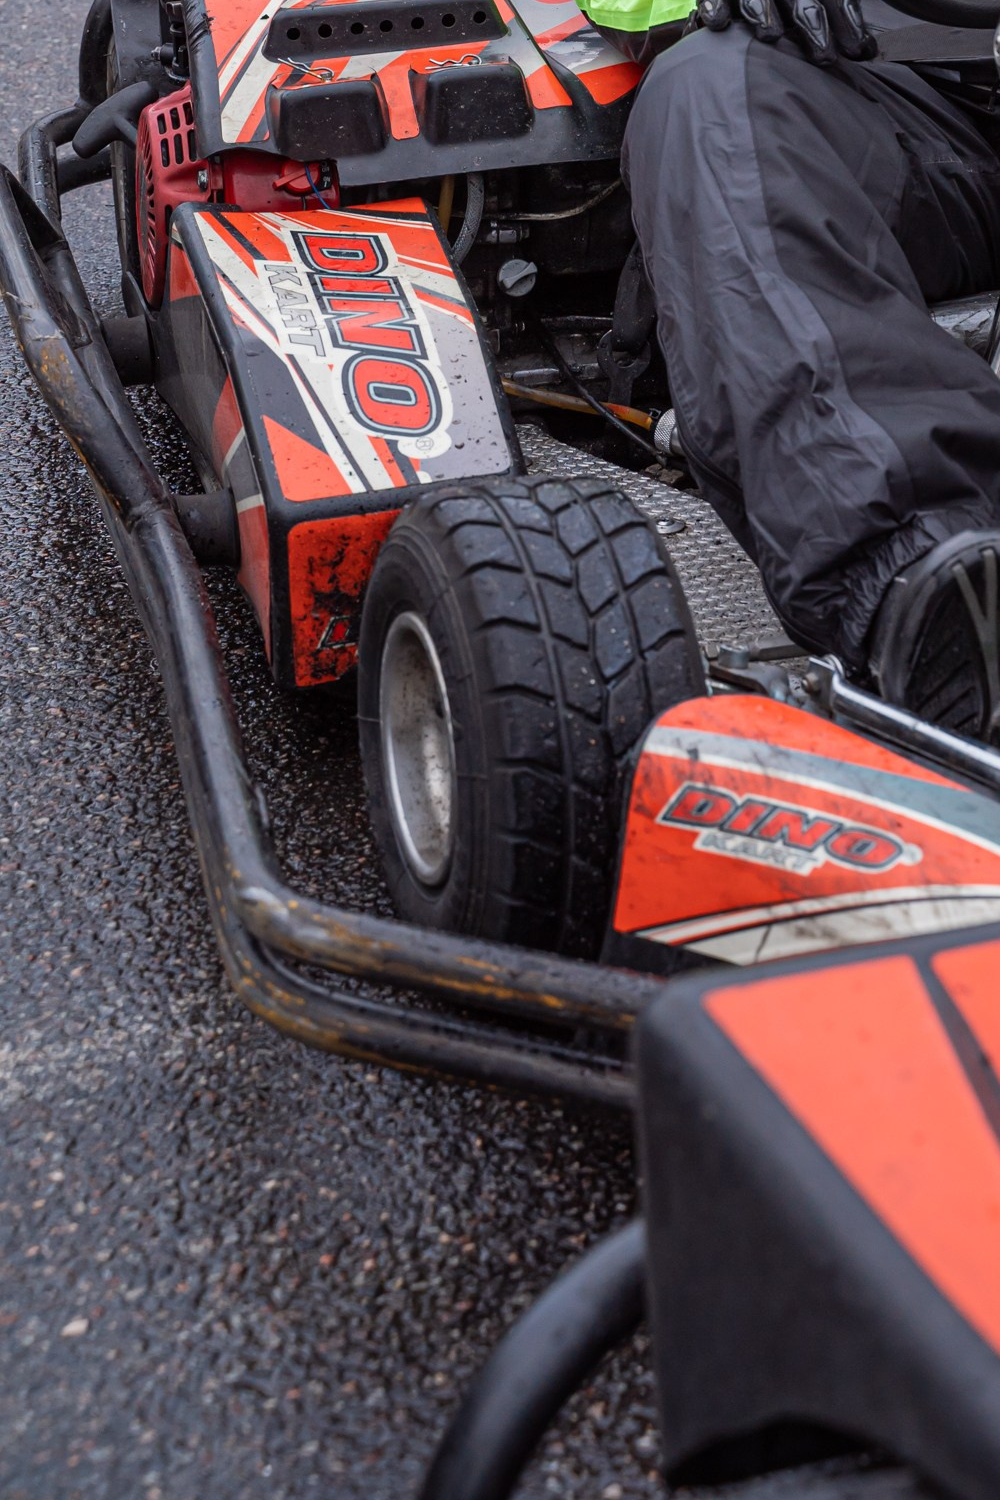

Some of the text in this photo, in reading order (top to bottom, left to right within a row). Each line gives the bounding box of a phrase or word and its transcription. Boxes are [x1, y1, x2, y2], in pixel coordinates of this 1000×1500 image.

[264, 264, 326, 357] KART
[290, 230, 443, 438] DINO
[661, 784, 904, 870] DINO
[702, 832, 819, 873] KART
